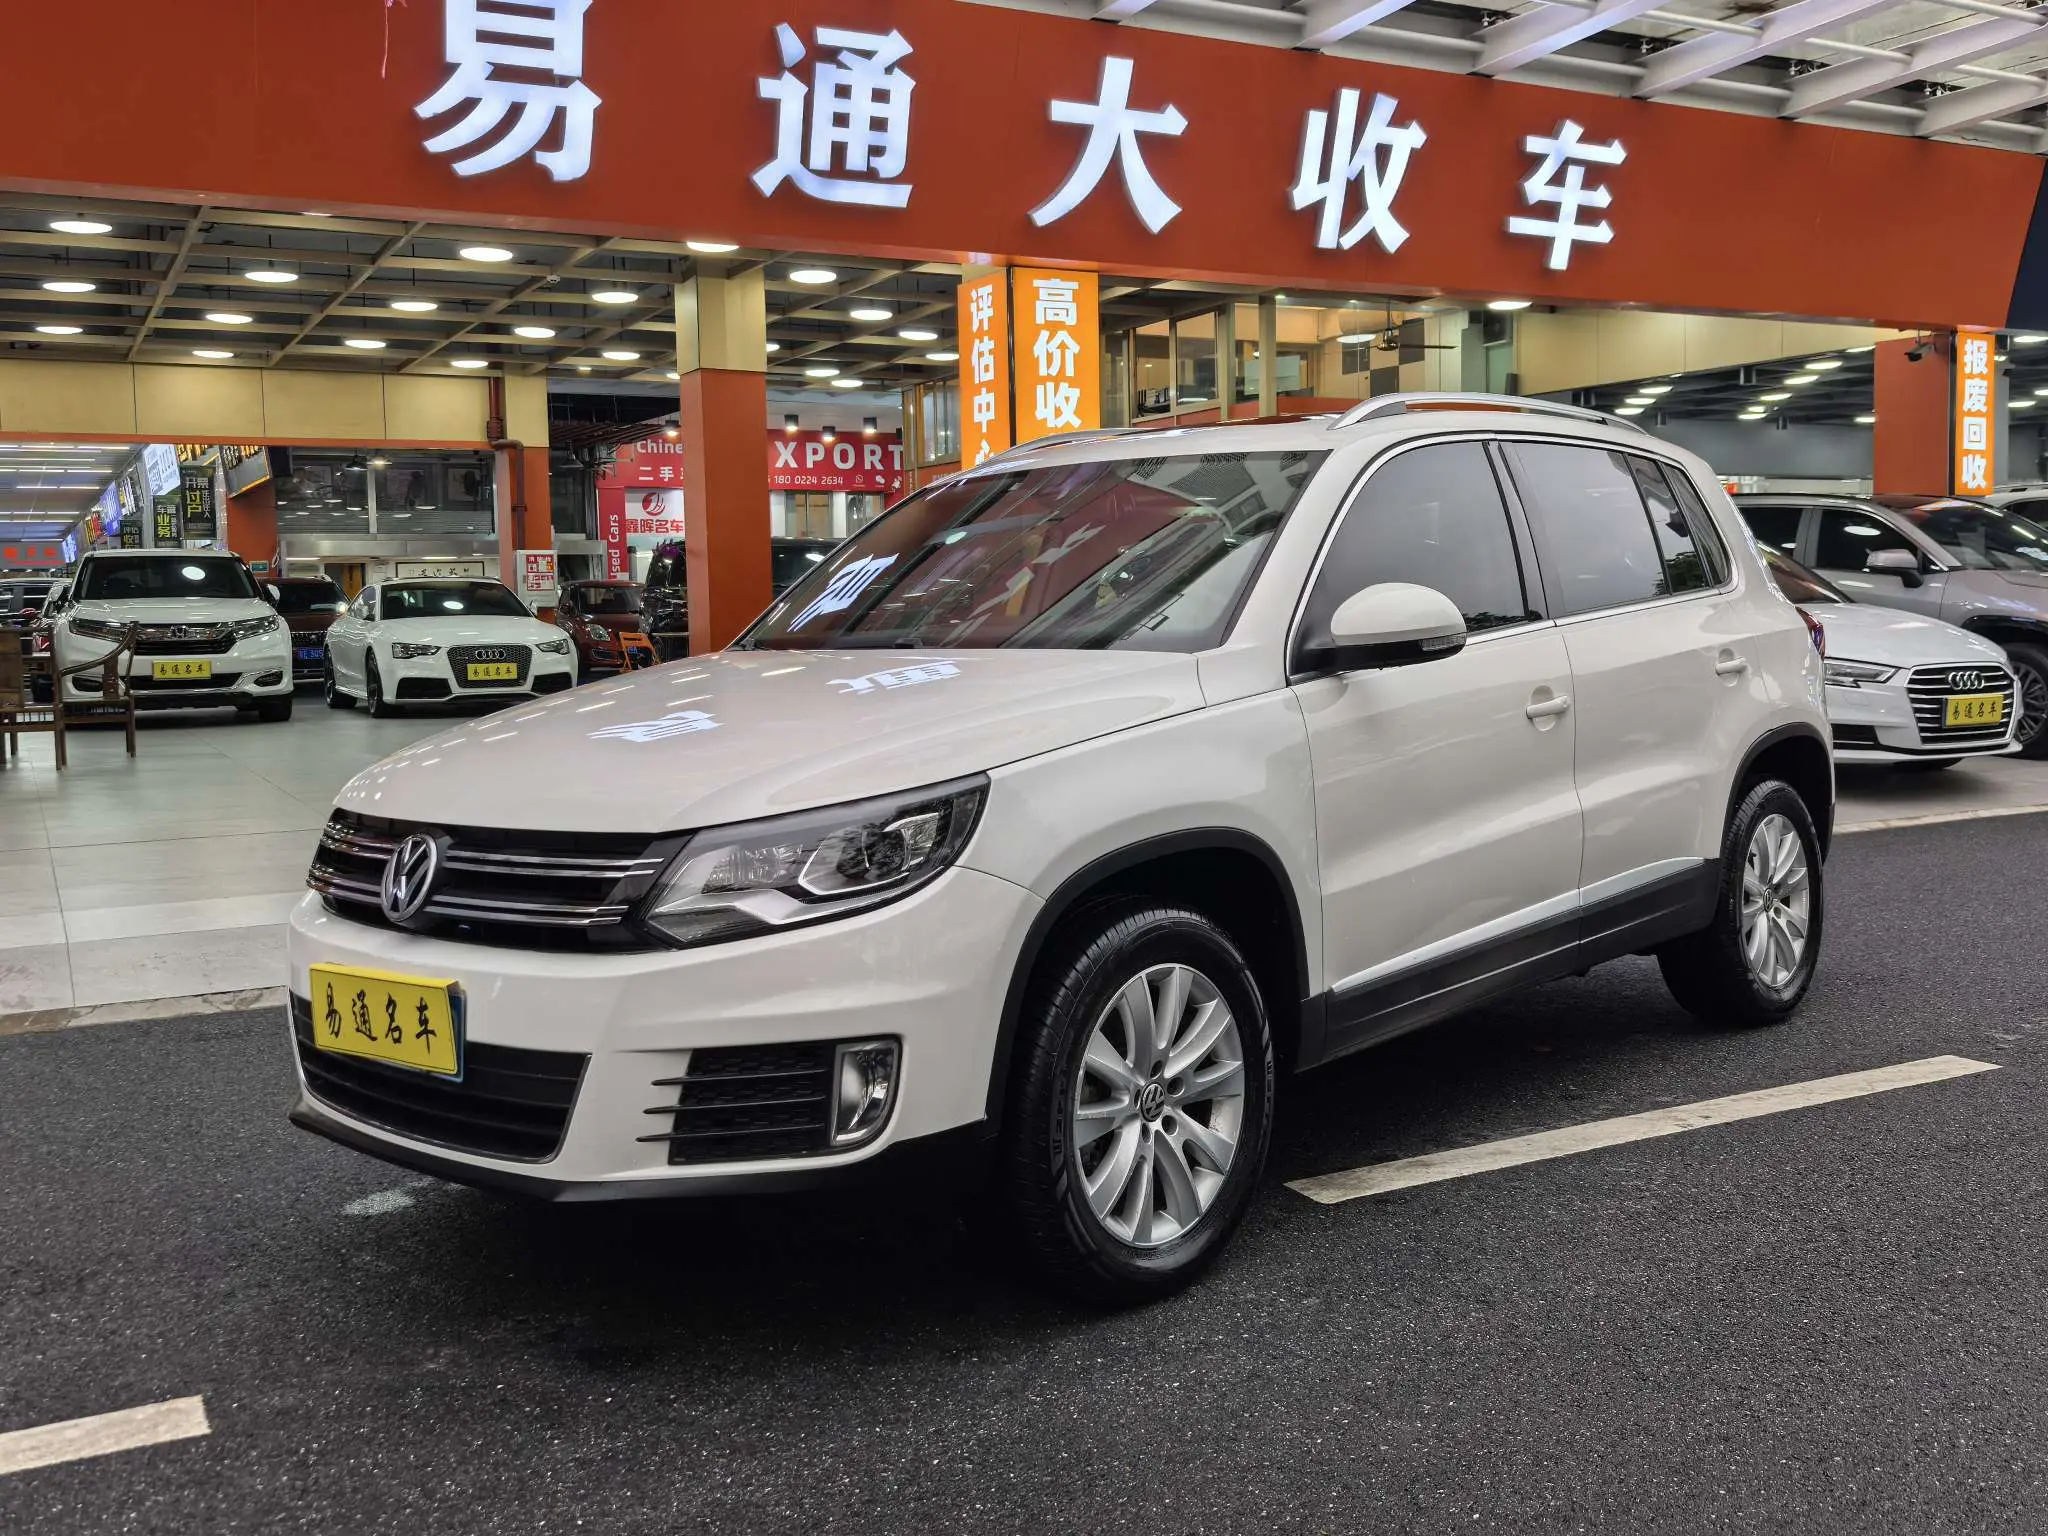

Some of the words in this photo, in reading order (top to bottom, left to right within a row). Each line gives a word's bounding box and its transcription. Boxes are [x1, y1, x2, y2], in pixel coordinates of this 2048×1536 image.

[414, 0, 1627, 271] 易通大收车
[1962, 338, 1988, 489] 报废回收
[774, 441, 904, 471] XPORT
[638, 466, 684, 482] 二手
[774, 475, 791, 484] 180
[794, 475, 817, 485] 0224
[821, 476, 843, 485] 2634
[608, 514, 619, 543] Cars
[324, 981, 437, 1054] 易通名车
